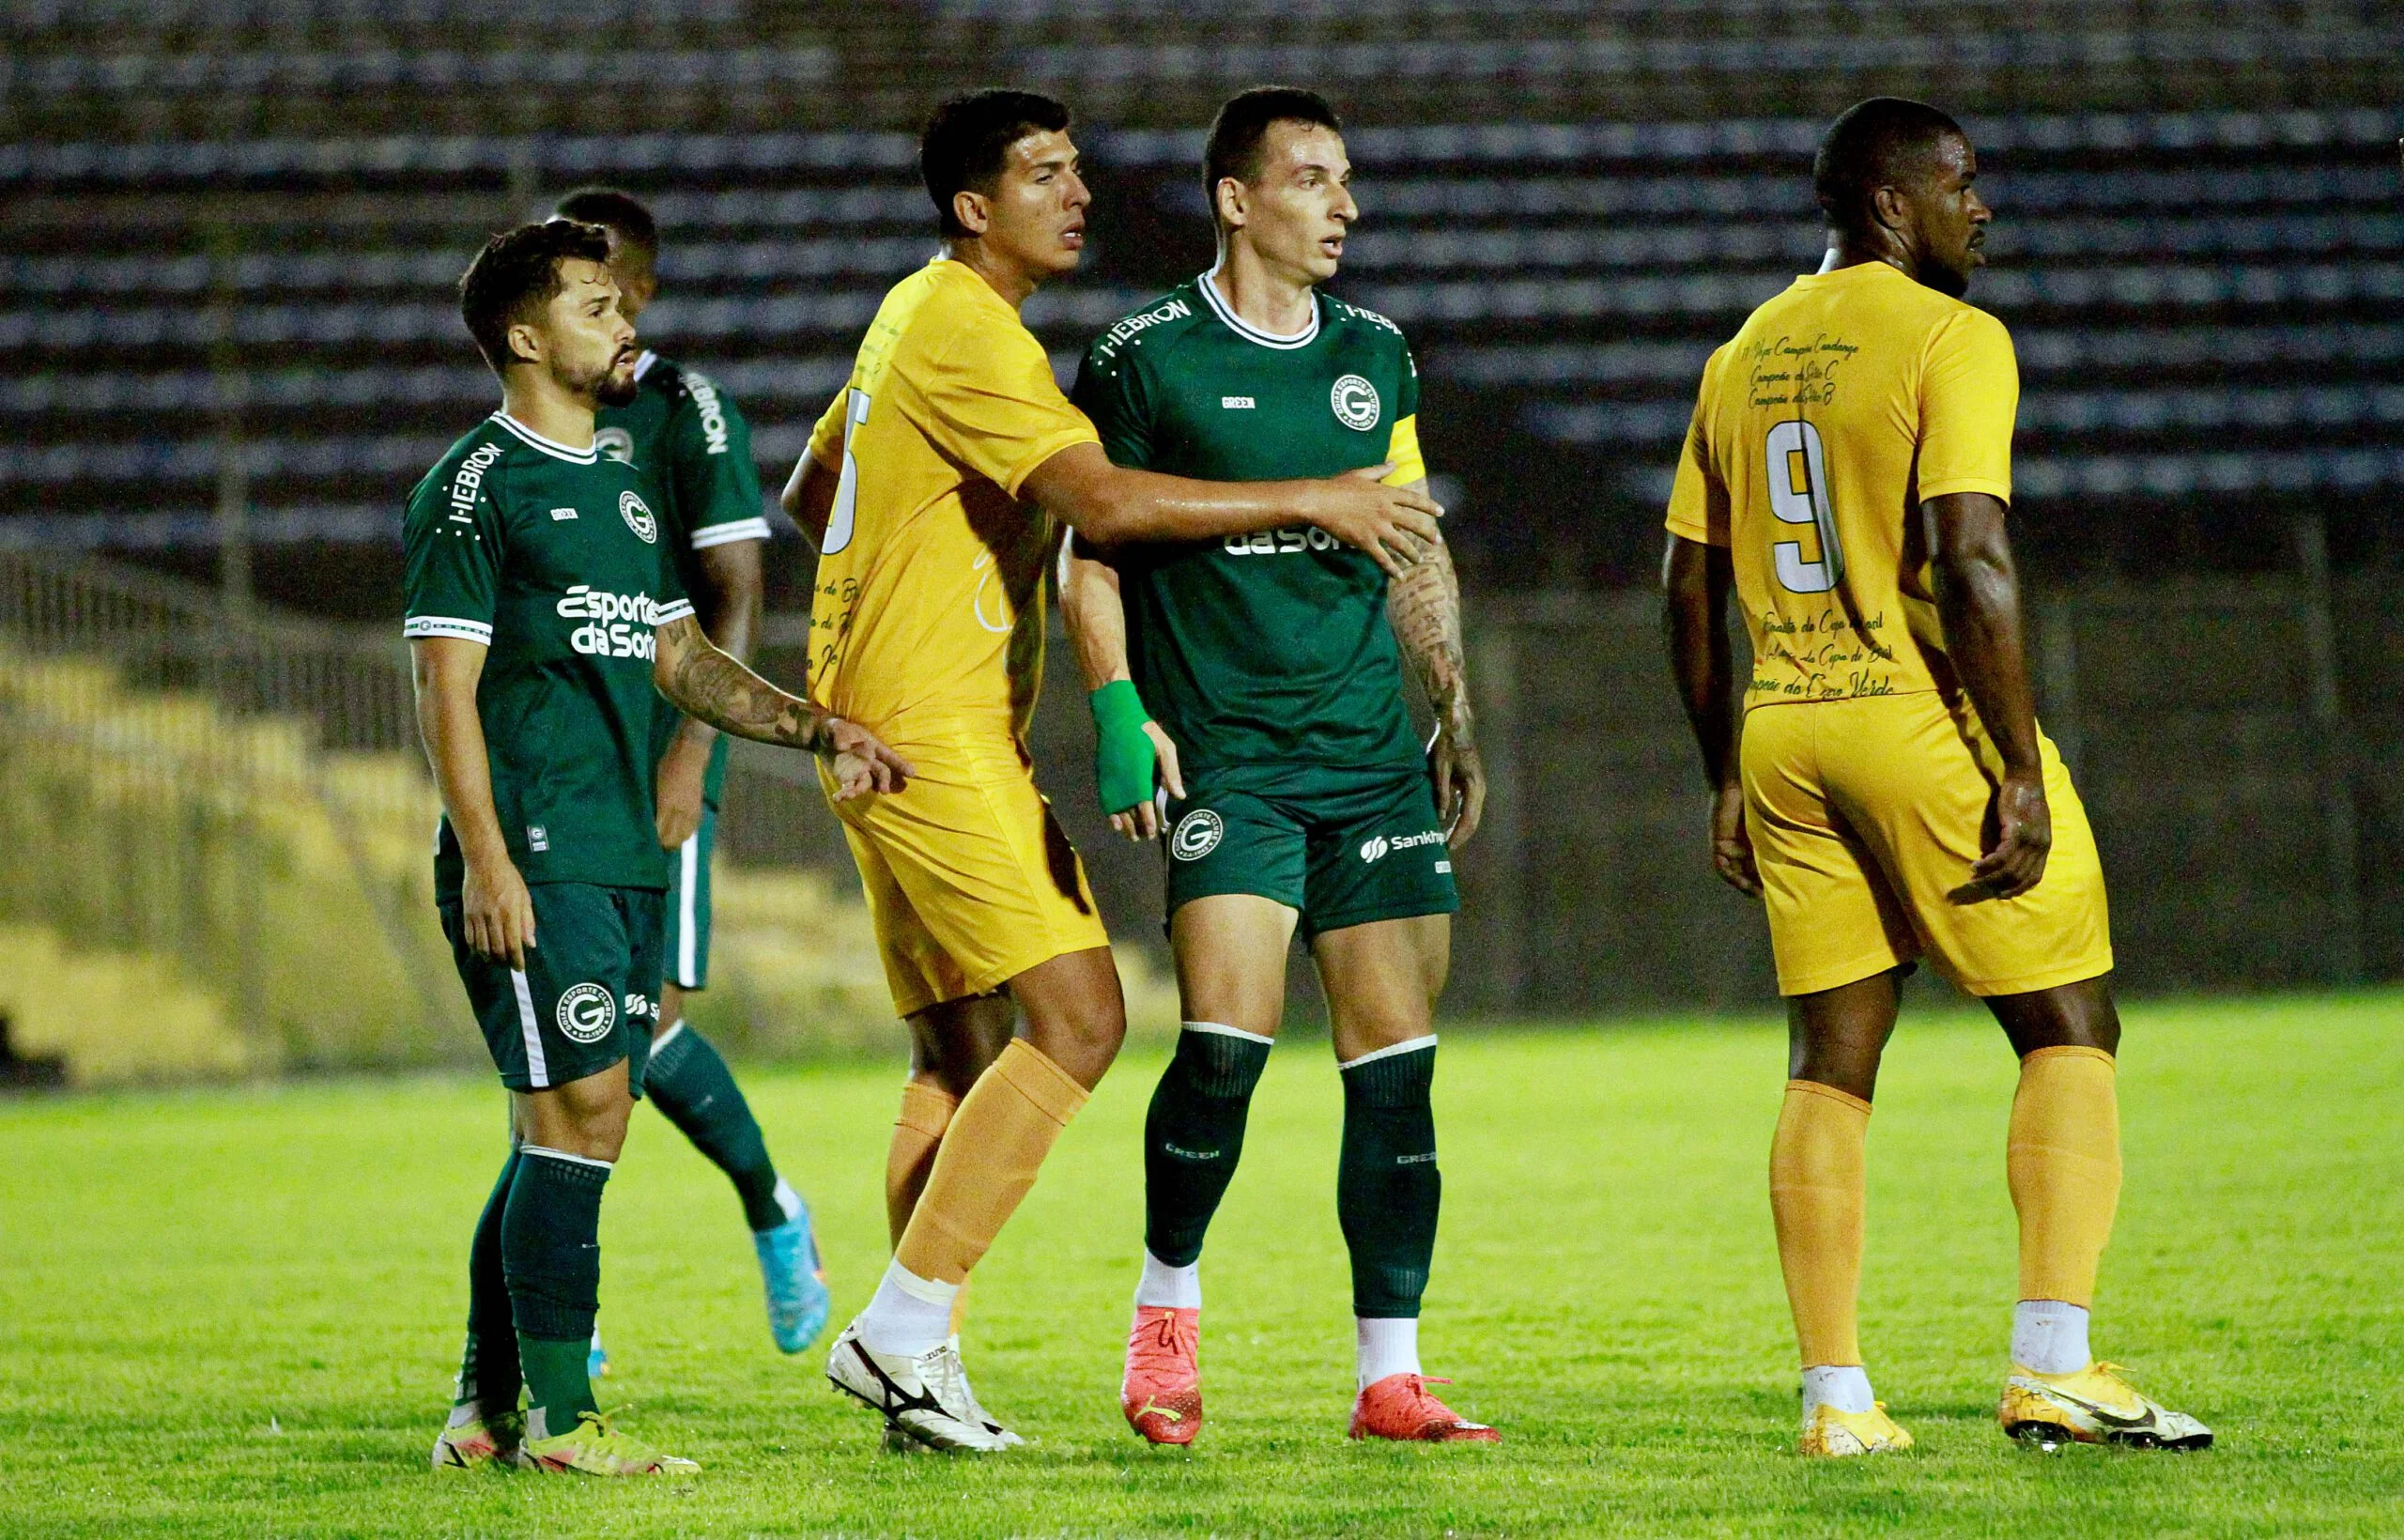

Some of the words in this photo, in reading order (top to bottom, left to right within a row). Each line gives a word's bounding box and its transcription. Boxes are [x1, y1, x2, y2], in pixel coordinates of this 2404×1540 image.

[1099, 299, 1192, 358] HEBRON
[448, 441, 505, 524] HEBRON
[1765, 419, 1845, 594] 9
